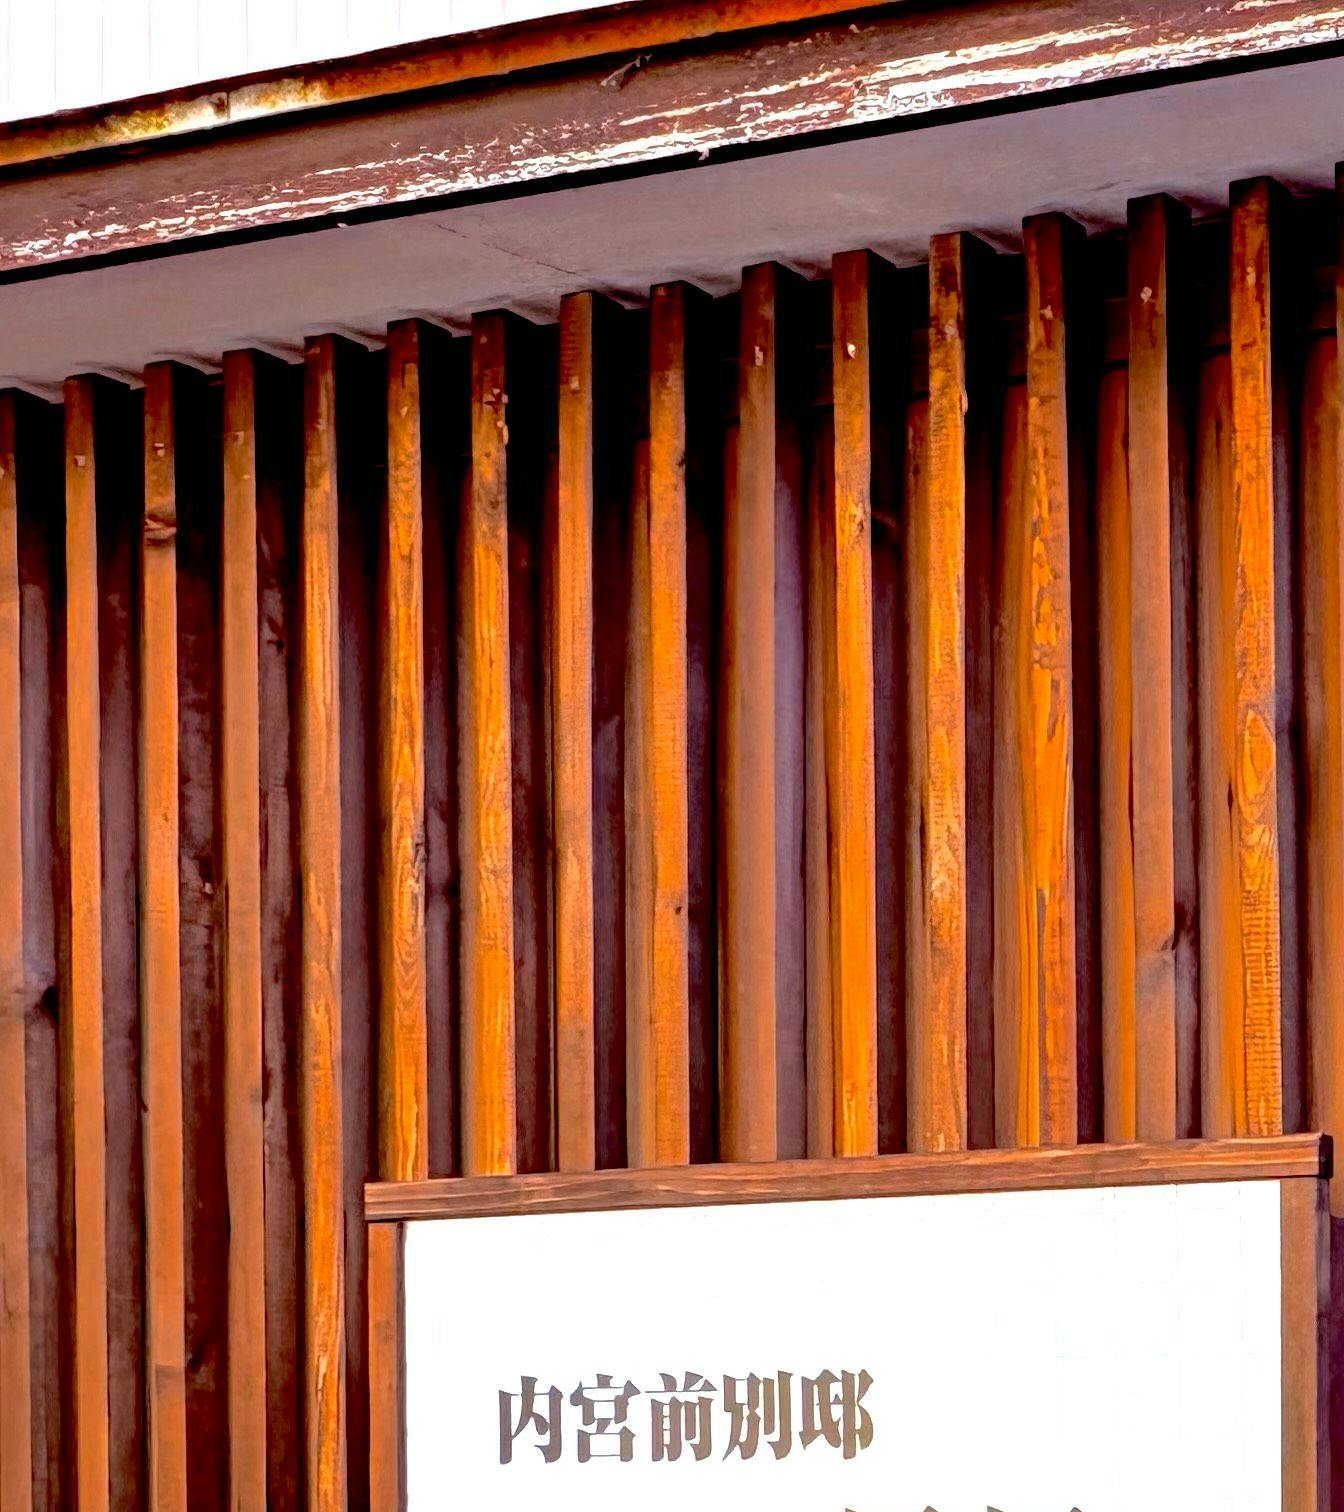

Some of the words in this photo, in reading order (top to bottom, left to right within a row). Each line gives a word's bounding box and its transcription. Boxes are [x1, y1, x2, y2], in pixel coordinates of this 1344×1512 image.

[498, 1369, 875, 1465] 内宮前別邸
